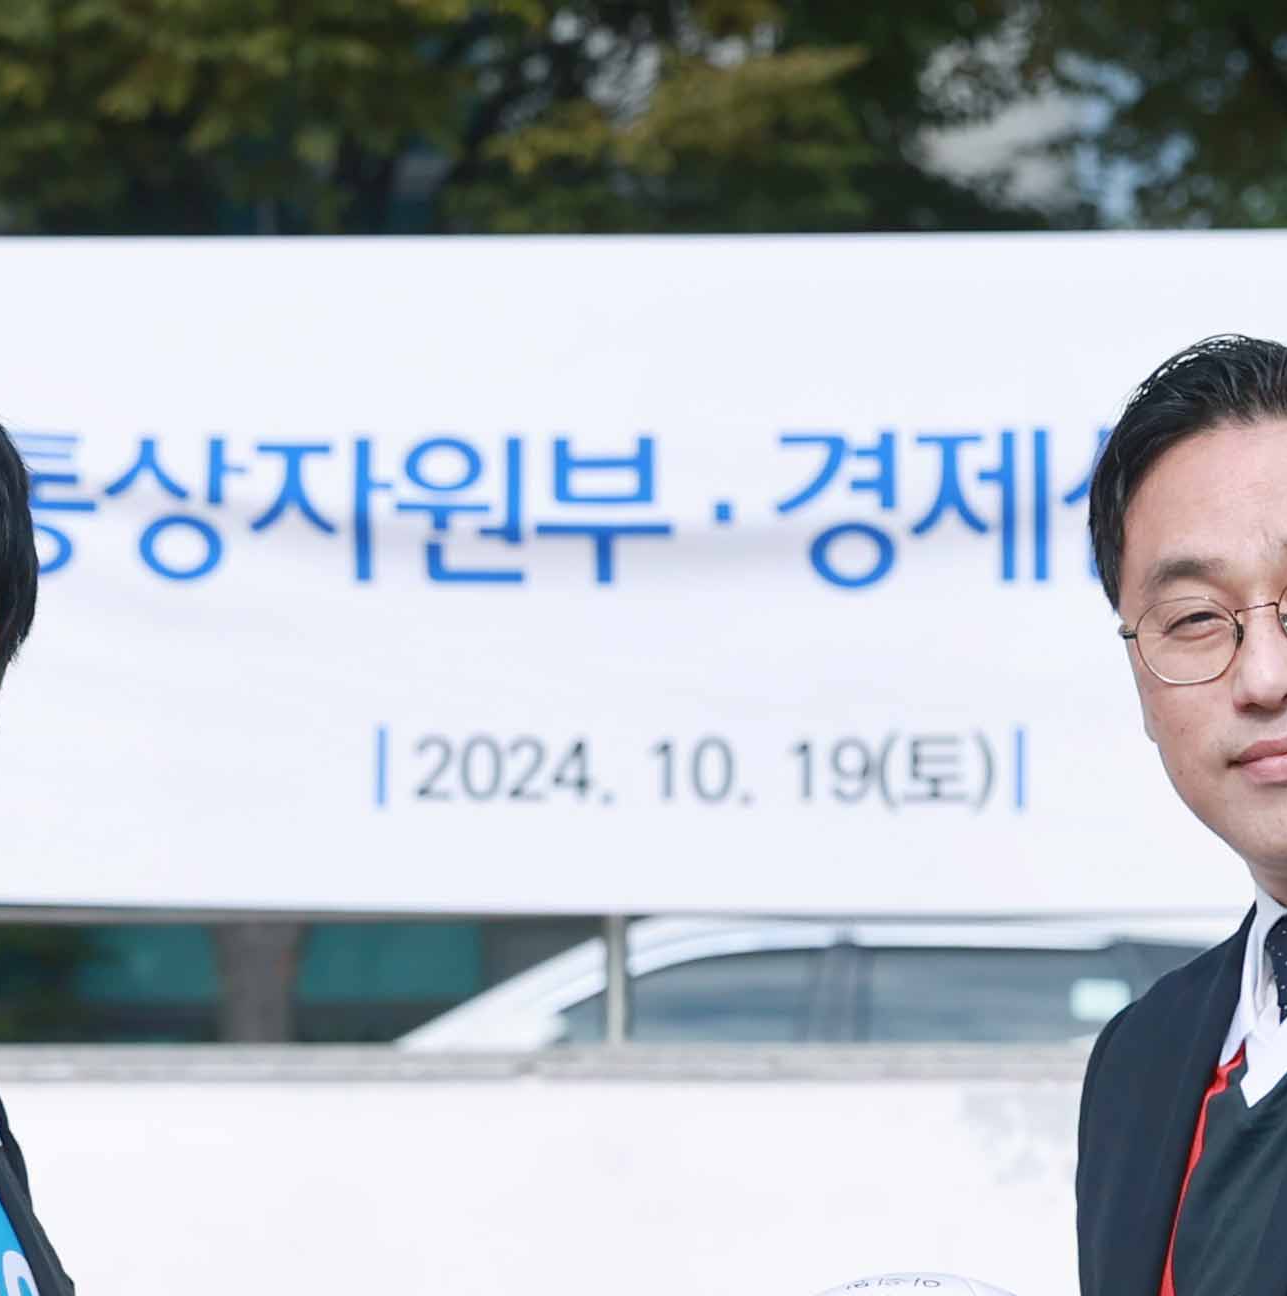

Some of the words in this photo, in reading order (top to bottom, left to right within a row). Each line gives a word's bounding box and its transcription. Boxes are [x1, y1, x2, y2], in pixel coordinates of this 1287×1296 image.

[775, 426, 1105, 588] 경제
[414, 733, 616, 806] 2024.
[655, 733, 755, 806] 10.
[791, 728, 997, 812] 19(토)
